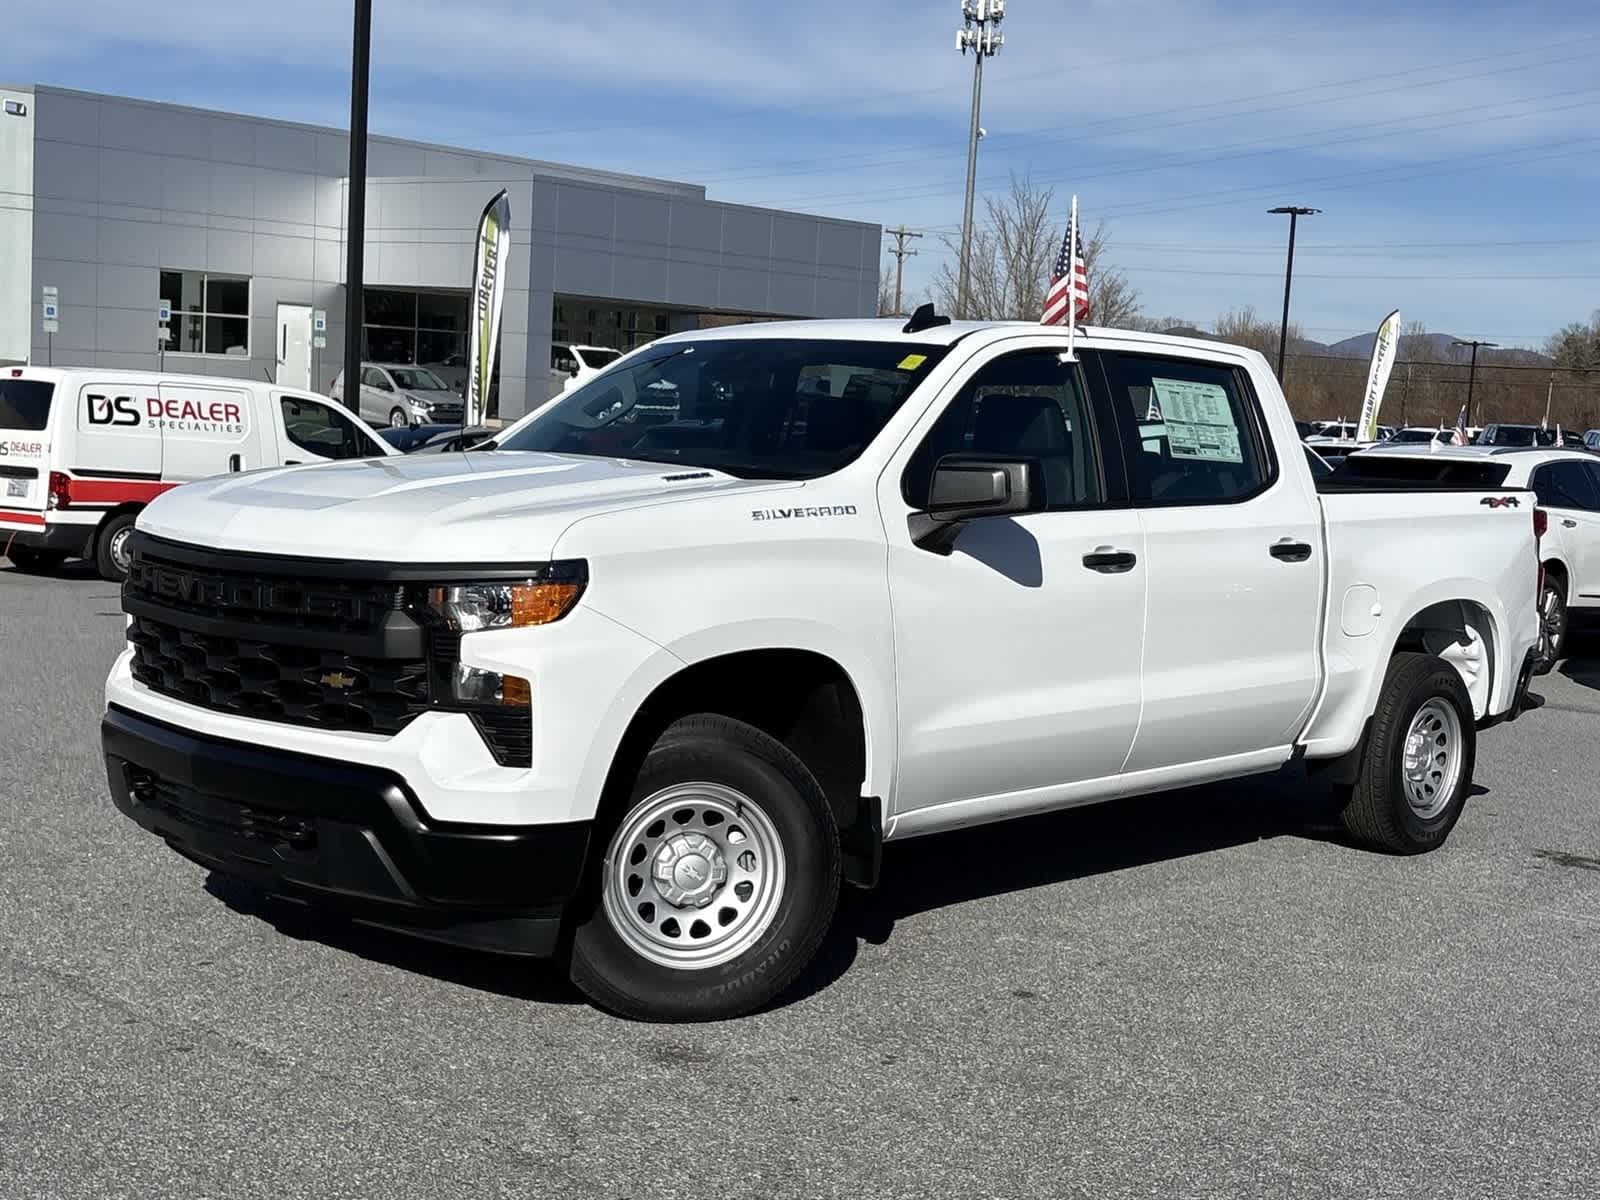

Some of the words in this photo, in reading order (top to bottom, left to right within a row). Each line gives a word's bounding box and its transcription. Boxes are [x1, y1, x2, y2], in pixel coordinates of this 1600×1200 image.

[87, 394, 141, 427] DS
[146, 398, 241, 423] DEALER
[147, 419, 242, 433] SPECIALTIES
[10, 441, 42, 454] DEALER
[751, 505, 857, 521] SILVERADO
